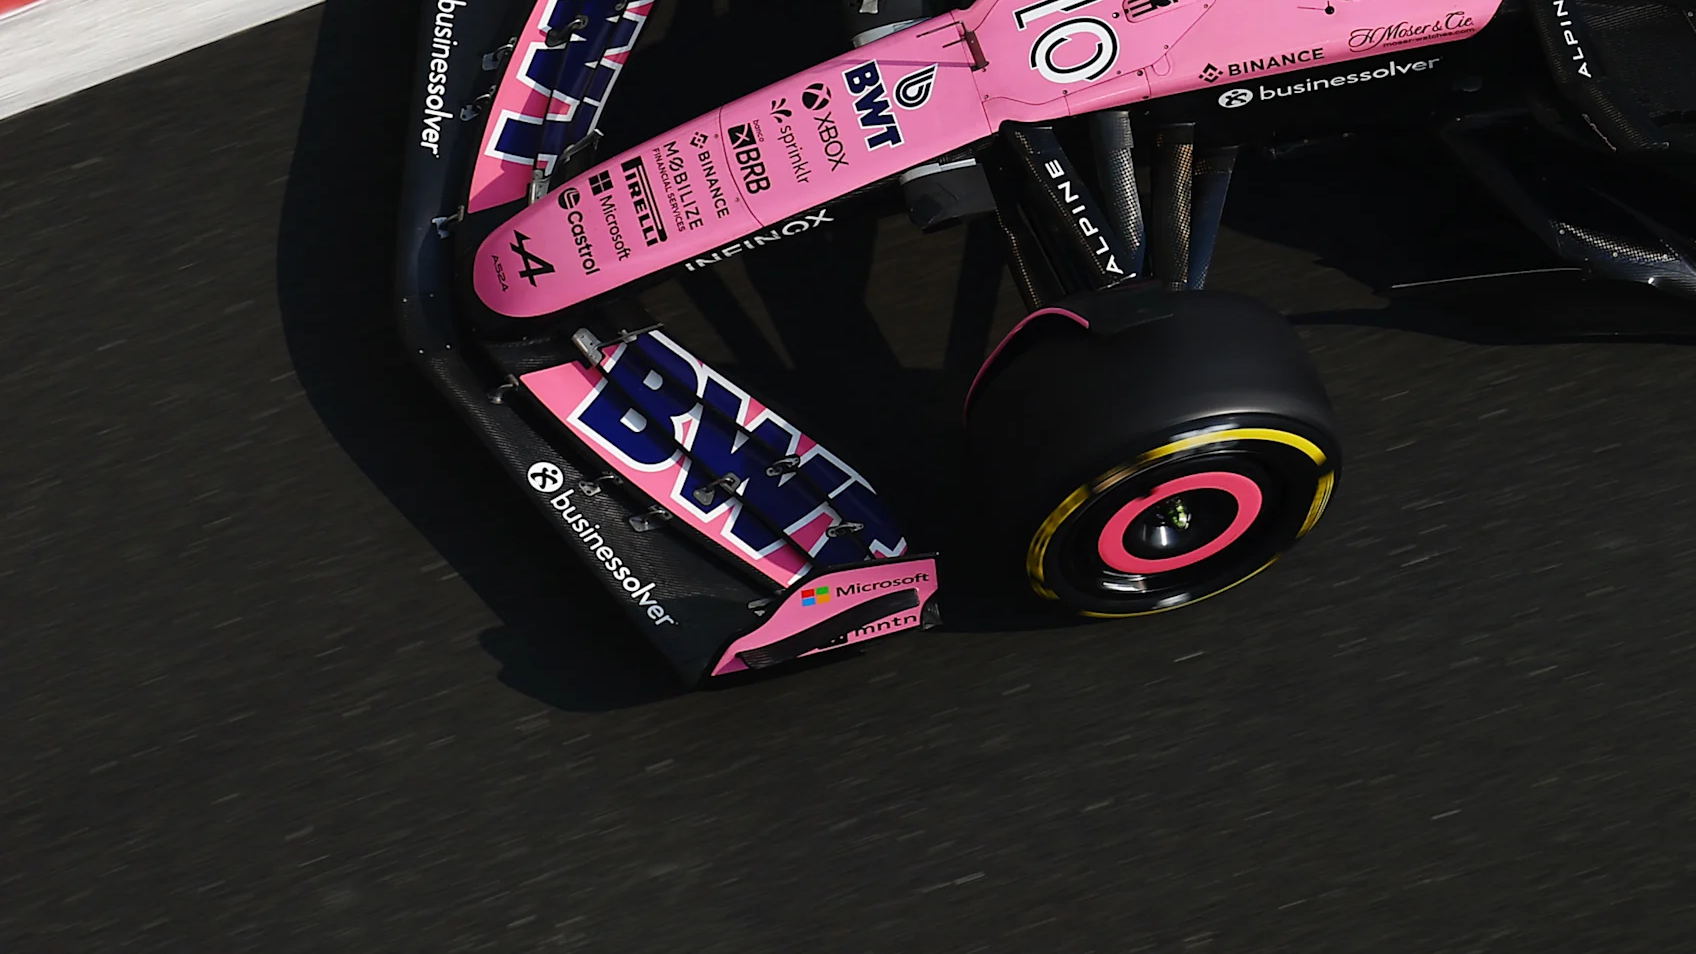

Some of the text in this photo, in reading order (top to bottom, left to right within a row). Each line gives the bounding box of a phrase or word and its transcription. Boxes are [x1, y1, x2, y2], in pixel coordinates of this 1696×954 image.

[1432, 20, 1443, 32] &
[1228, 47, 1325, 77] BINANCE
[1260, 56, 1440, 102] businessolver
[752, 119, 765, 142] banco
[842, 59, 905, 152] BWT
[735, 146, 771, 195] BRB
[778, 125, 812, 183] sprinklr
[814, 111, 849, 172] XBOX
[621, 155, 668, 247] PIRELLI
[652, 147, 686, 233] FINANCIAL SERVICES
[698, 150, 730, 219] BINANCE
[567, 210, 601, 276] Castrol
[600, 194, 632, 262] Microsoft
[1044, 159, 1124, 275] ALPINE
[567, 330, 906, 588] BWT
[550, 489, 674, 626] businessolver
[836, 572, 930, 597] Microsoft
[855, 614, 917, 637] mntn
